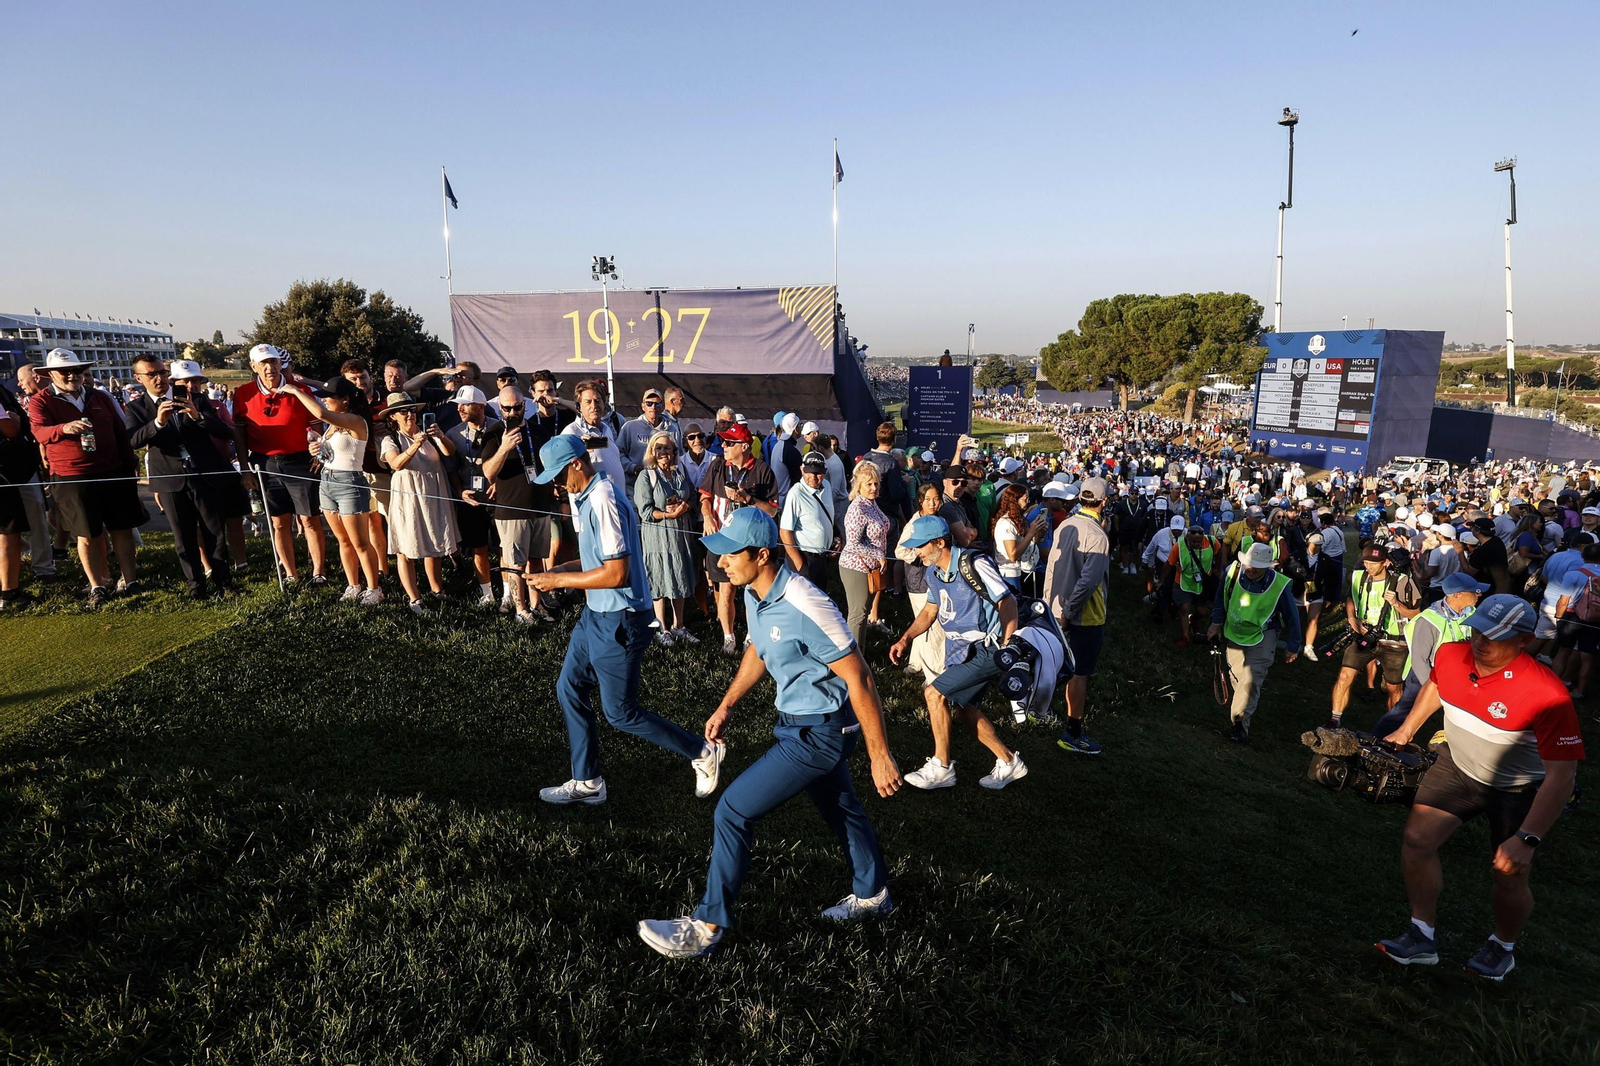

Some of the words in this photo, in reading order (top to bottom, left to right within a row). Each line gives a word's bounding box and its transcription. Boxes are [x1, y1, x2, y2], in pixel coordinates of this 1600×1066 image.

[625, 340, 640, 350] SINCE
[936, 370, 942, 380] 1
[961, 554, 982, 590] EUROPE
